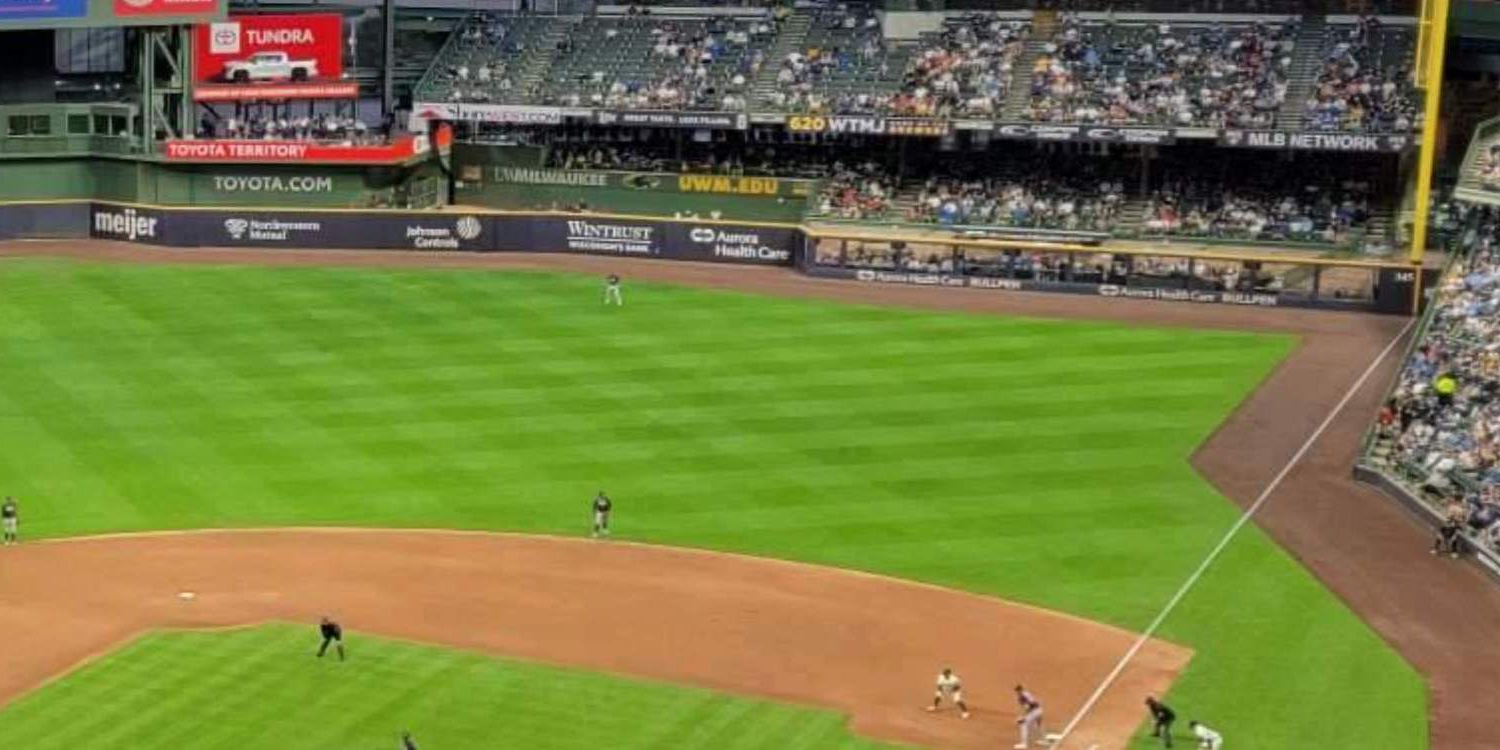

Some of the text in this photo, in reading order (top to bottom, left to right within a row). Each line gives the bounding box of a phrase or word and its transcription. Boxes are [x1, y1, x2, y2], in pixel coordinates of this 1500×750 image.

[246, 28, 315, 45] TUNDRA
[789, 116, 825, 131] 620
[827, 117, 886, 133] WTMJ
[1249, 132, 1379, 150] MLB NETWORK
[169, 144, 309, 158] TOYOTA TERRITORY
[214, 176, 333, 192] TOYOTA.COM
[678, 174, 779, 195] UWM.EDU
[94, 208, 158, 240] meijer
[716, 231, 759, 244] Aurora
[715, 243, 790, 260] Health Care
